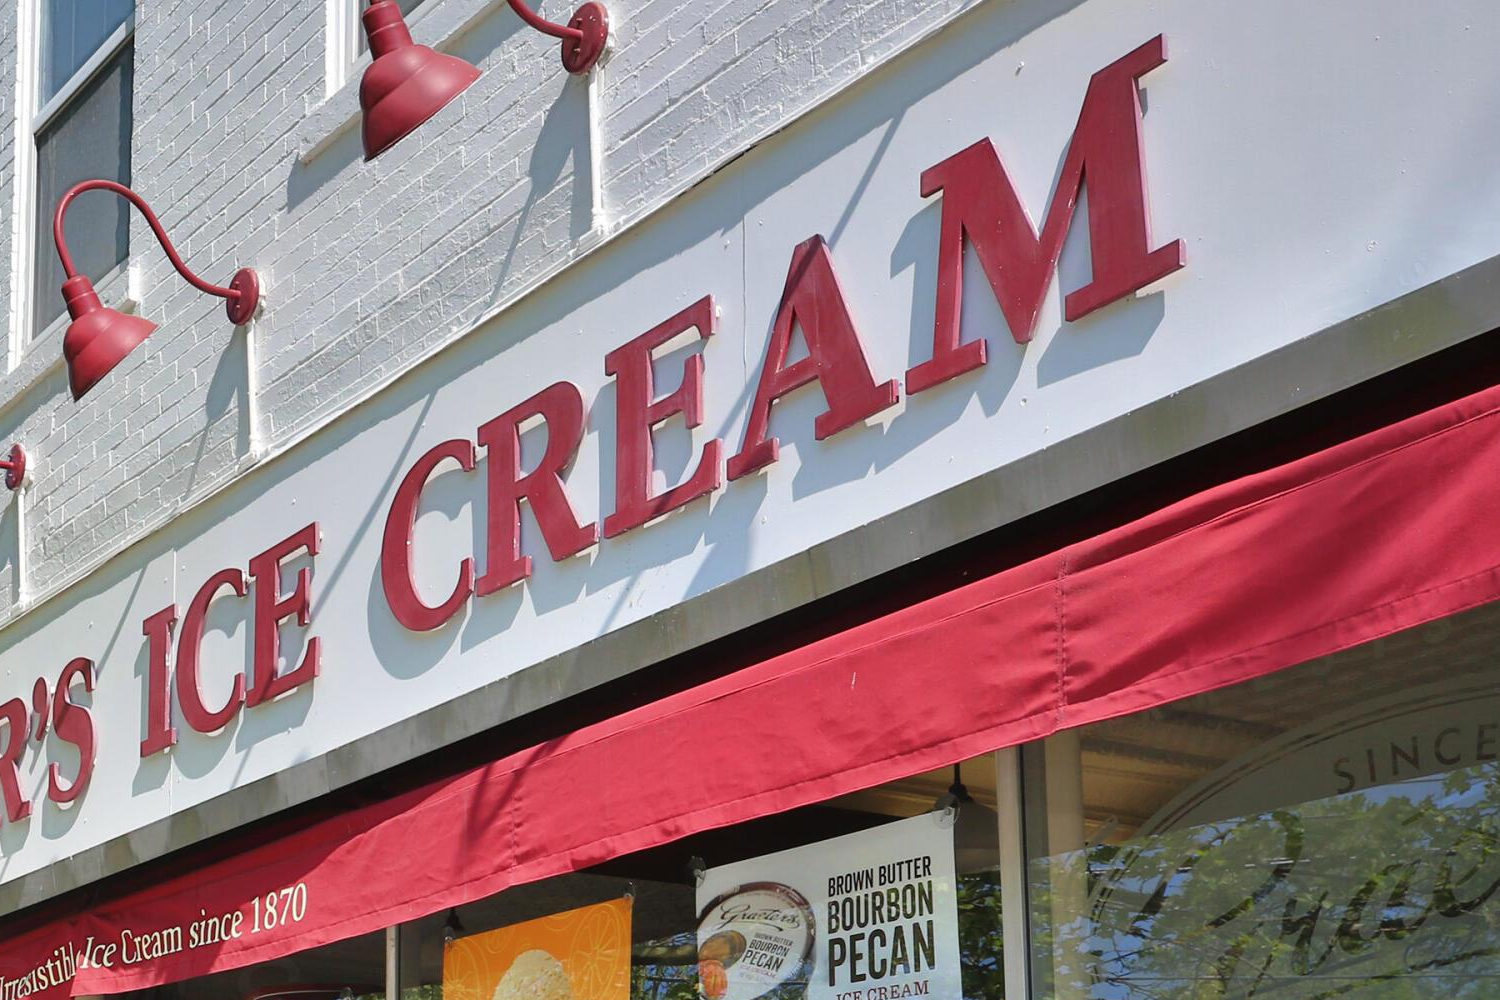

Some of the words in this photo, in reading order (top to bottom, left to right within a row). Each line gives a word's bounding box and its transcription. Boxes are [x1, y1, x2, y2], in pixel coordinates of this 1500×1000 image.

[140, 522, 321, 757] ICE
[381, 33, 1187, 633] CREAM
[1333, 723, 1500, 795] SINCE
[828, 868, 874, 897] BROWN
[879, 855, 932, 886] BUTTER
[80, 937, 117, 970] Ice
[121, 926, 183, 966] Cream
[189, 909, 243, 949] since
[251, 882, 308, 930] 1870
[828, 880, 934, 934] BOURBON
[742, 949, 784, 973] PECAN
[748, 939, 790, 958] BOURBON
[828, 920, 935, 987] PECAN
